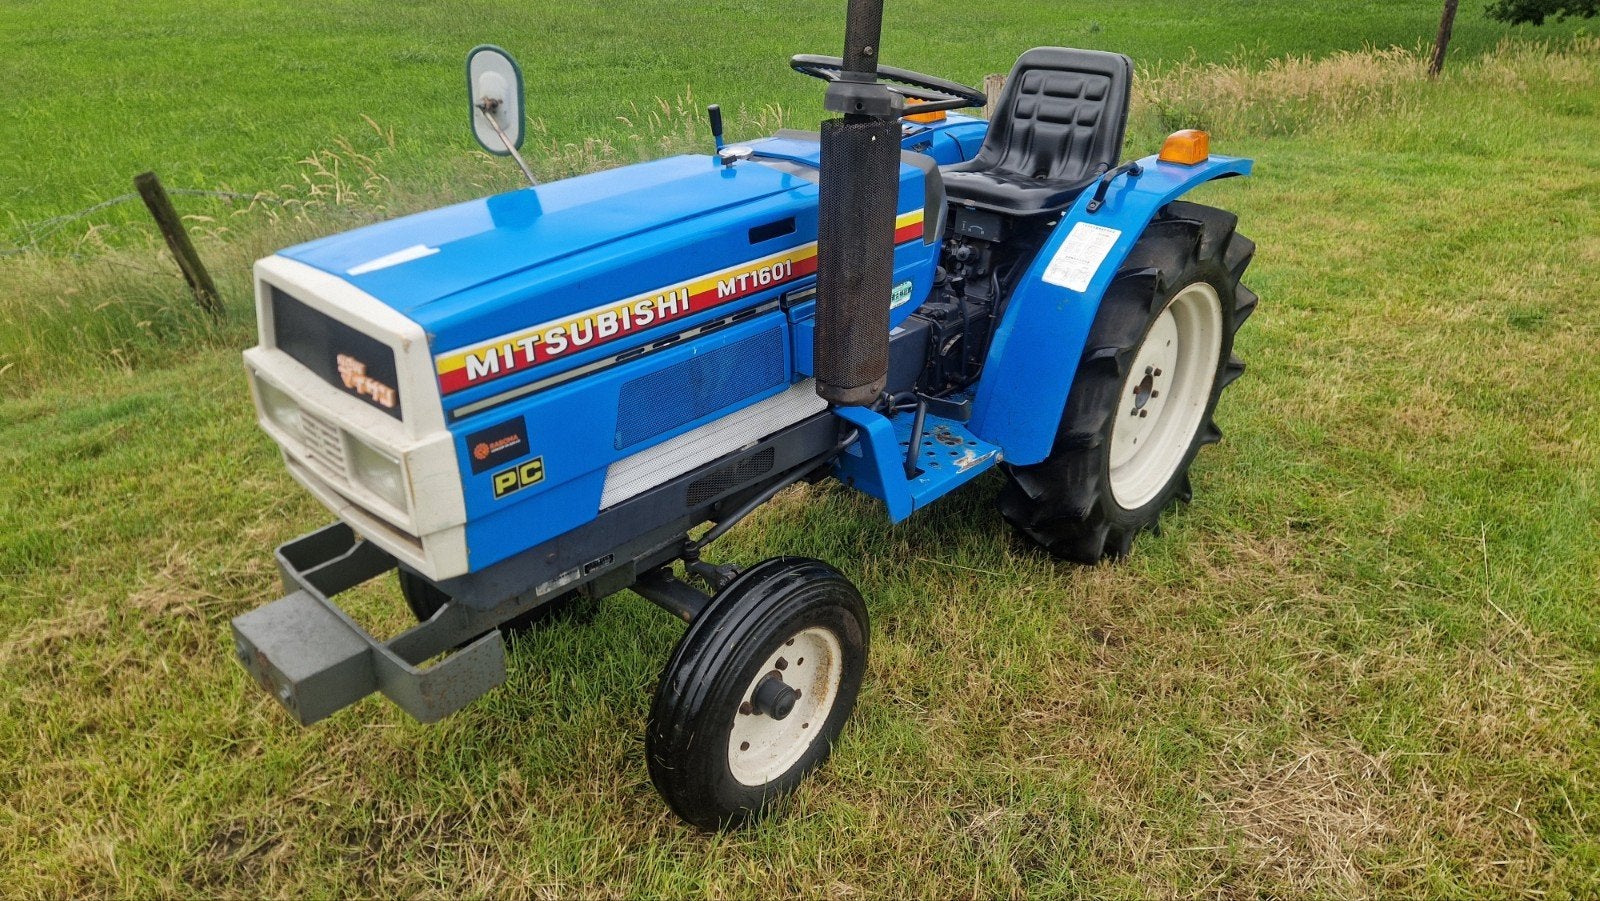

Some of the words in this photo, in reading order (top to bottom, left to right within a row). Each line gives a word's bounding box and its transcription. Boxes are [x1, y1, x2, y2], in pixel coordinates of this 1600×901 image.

[464, 287, 690, 382] MITSUBISHI
[717, 259, 793, 299] MT1601
[494, 460, 542, 495] PC
